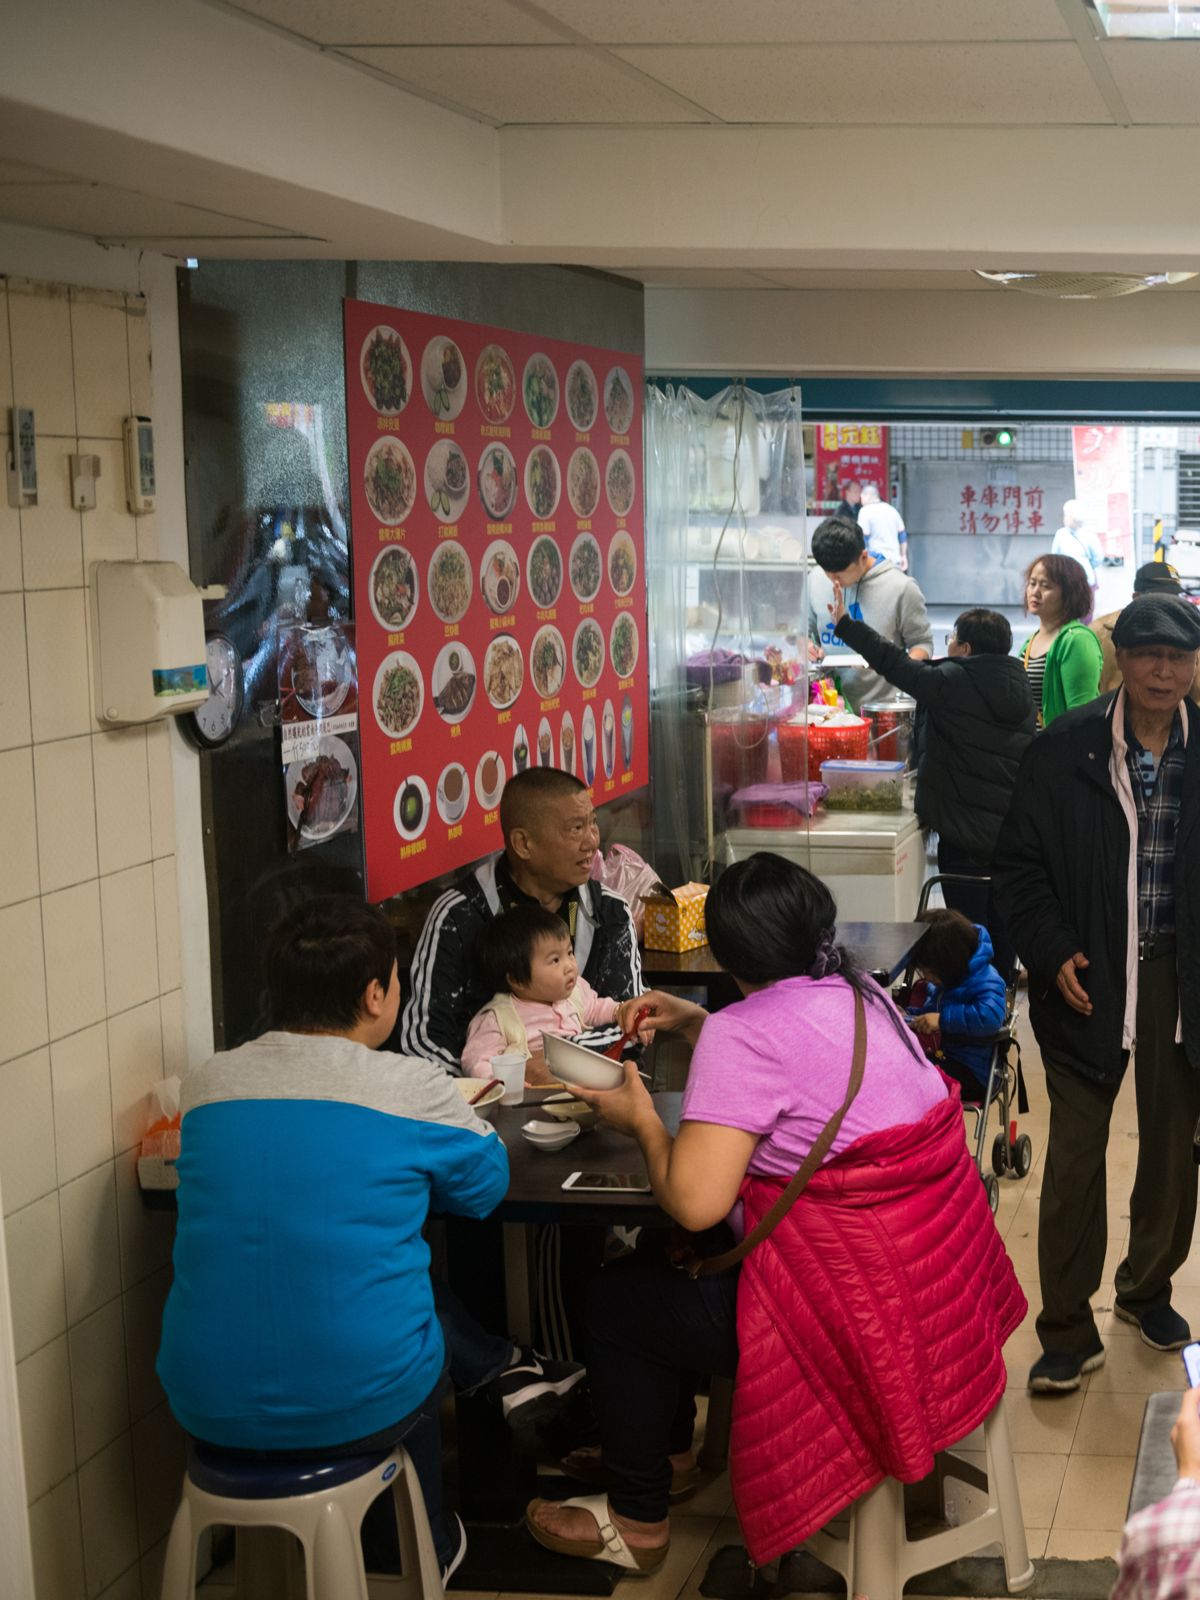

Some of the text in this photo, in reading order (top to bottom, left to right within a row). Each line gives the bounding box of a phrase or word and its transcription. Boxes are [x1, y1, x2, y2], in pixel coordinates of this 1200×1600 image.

[960, 485, 1045, 510] 車庫門前
[960, 510, 1045, 535] 請勿停車
